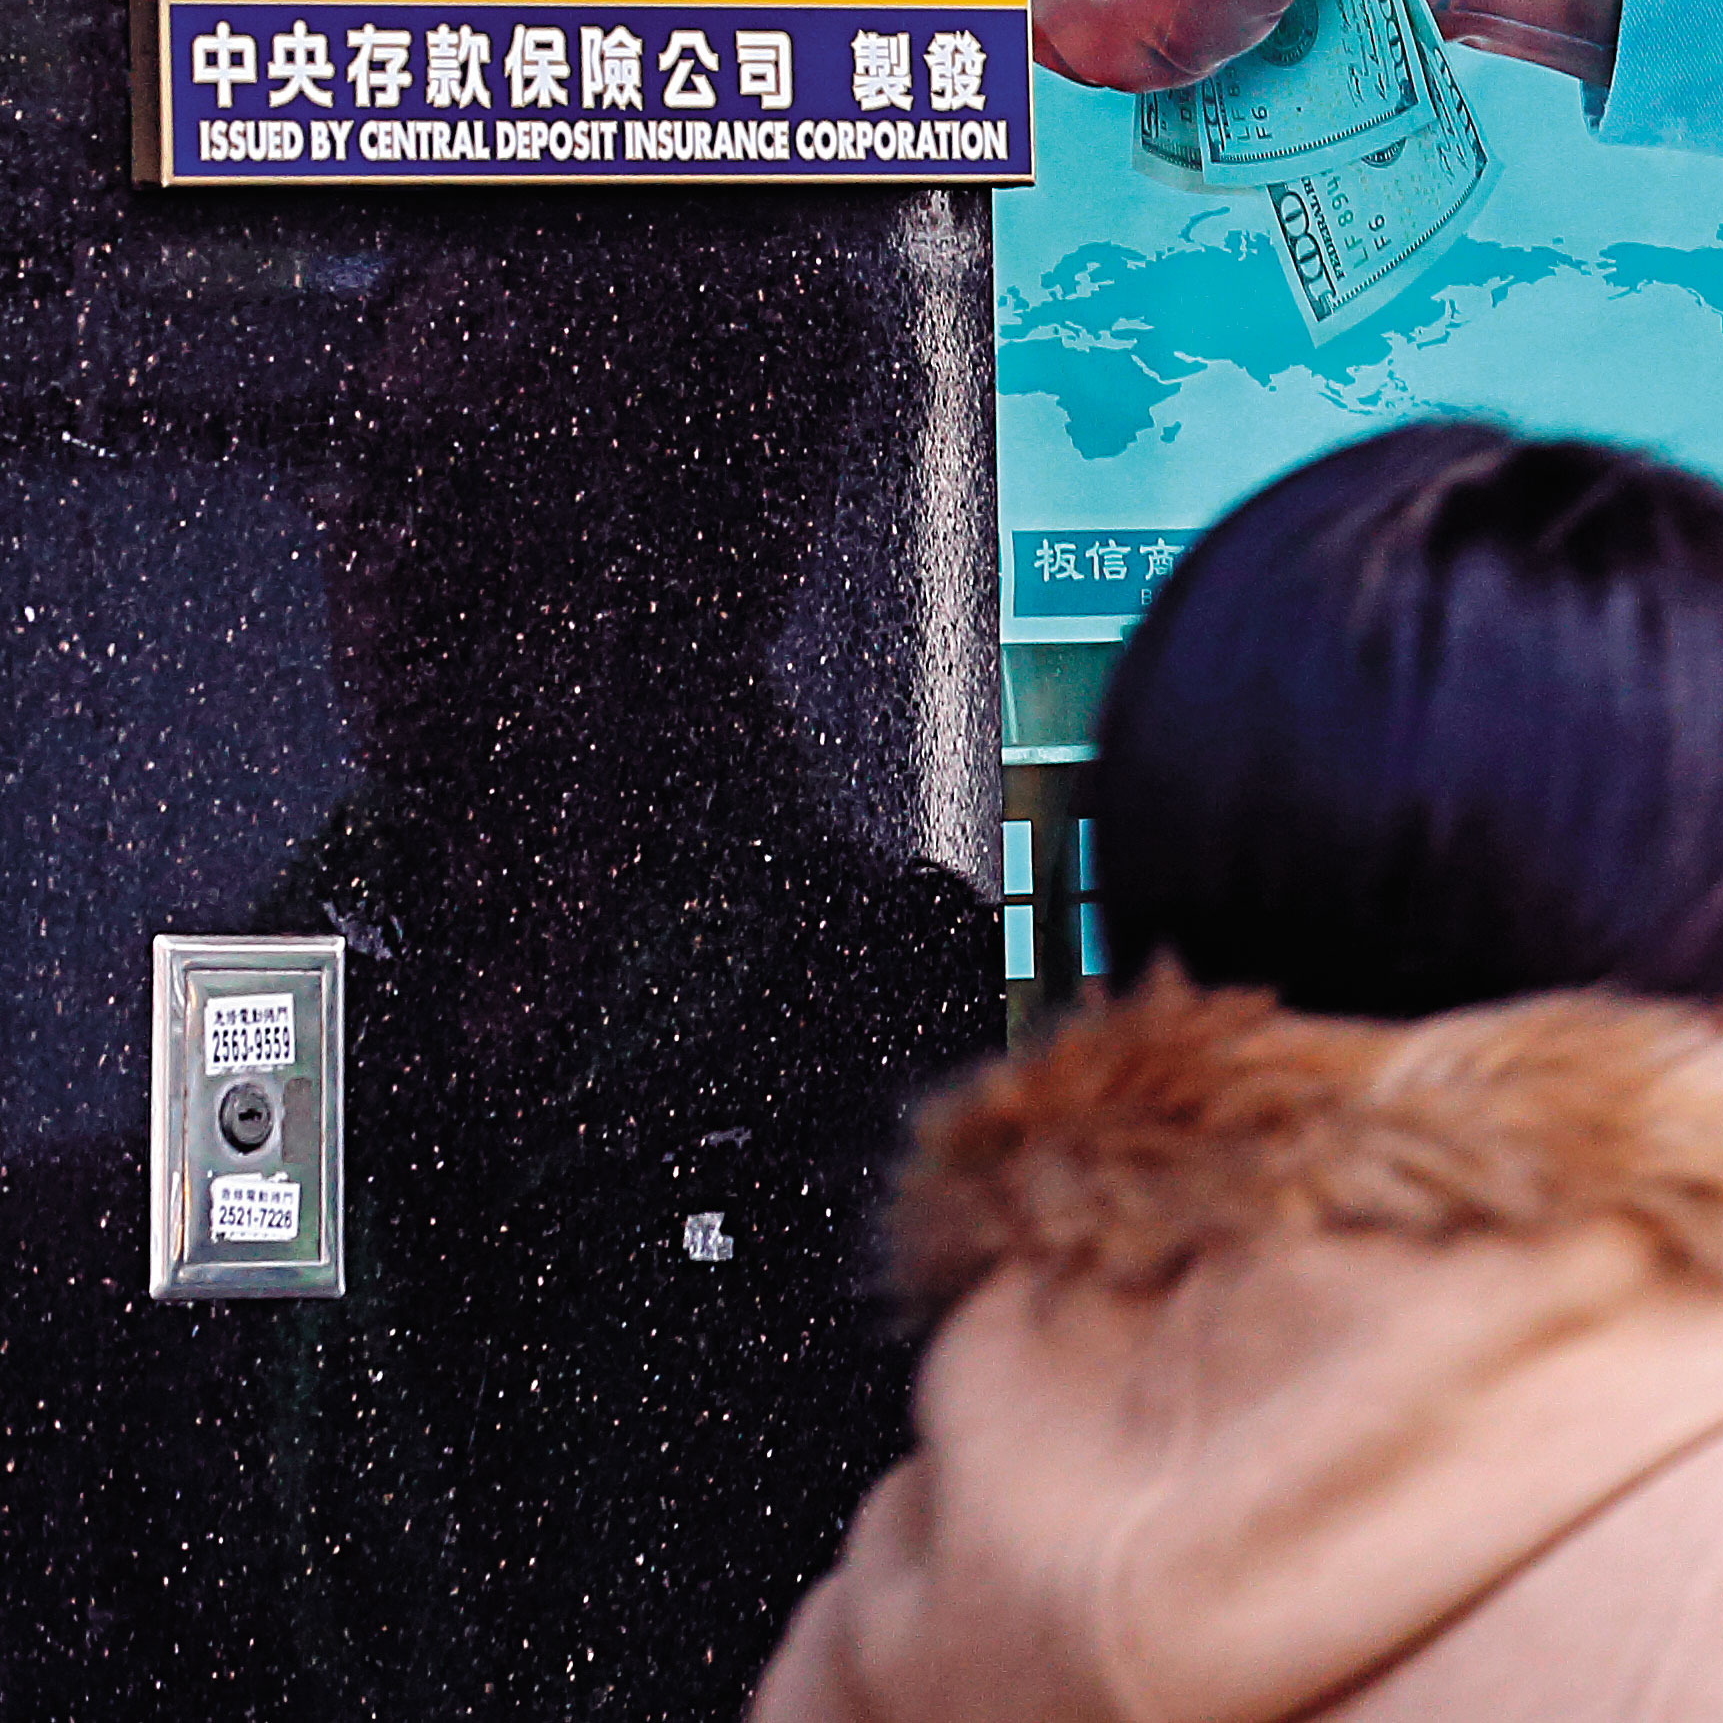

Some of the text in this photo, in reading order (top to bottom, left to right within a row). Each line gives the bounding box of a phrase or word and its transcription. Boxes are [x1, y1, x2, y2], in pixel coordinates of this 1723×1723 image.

[190, 22, 988, 112] 中央存款保險公司 製發
[199, 120, 1009, 163] ISSUED BY CENTRAL DEPOSIT INSURANCE CORPORATION
[1033, 537, 1186, 583] 板信商
